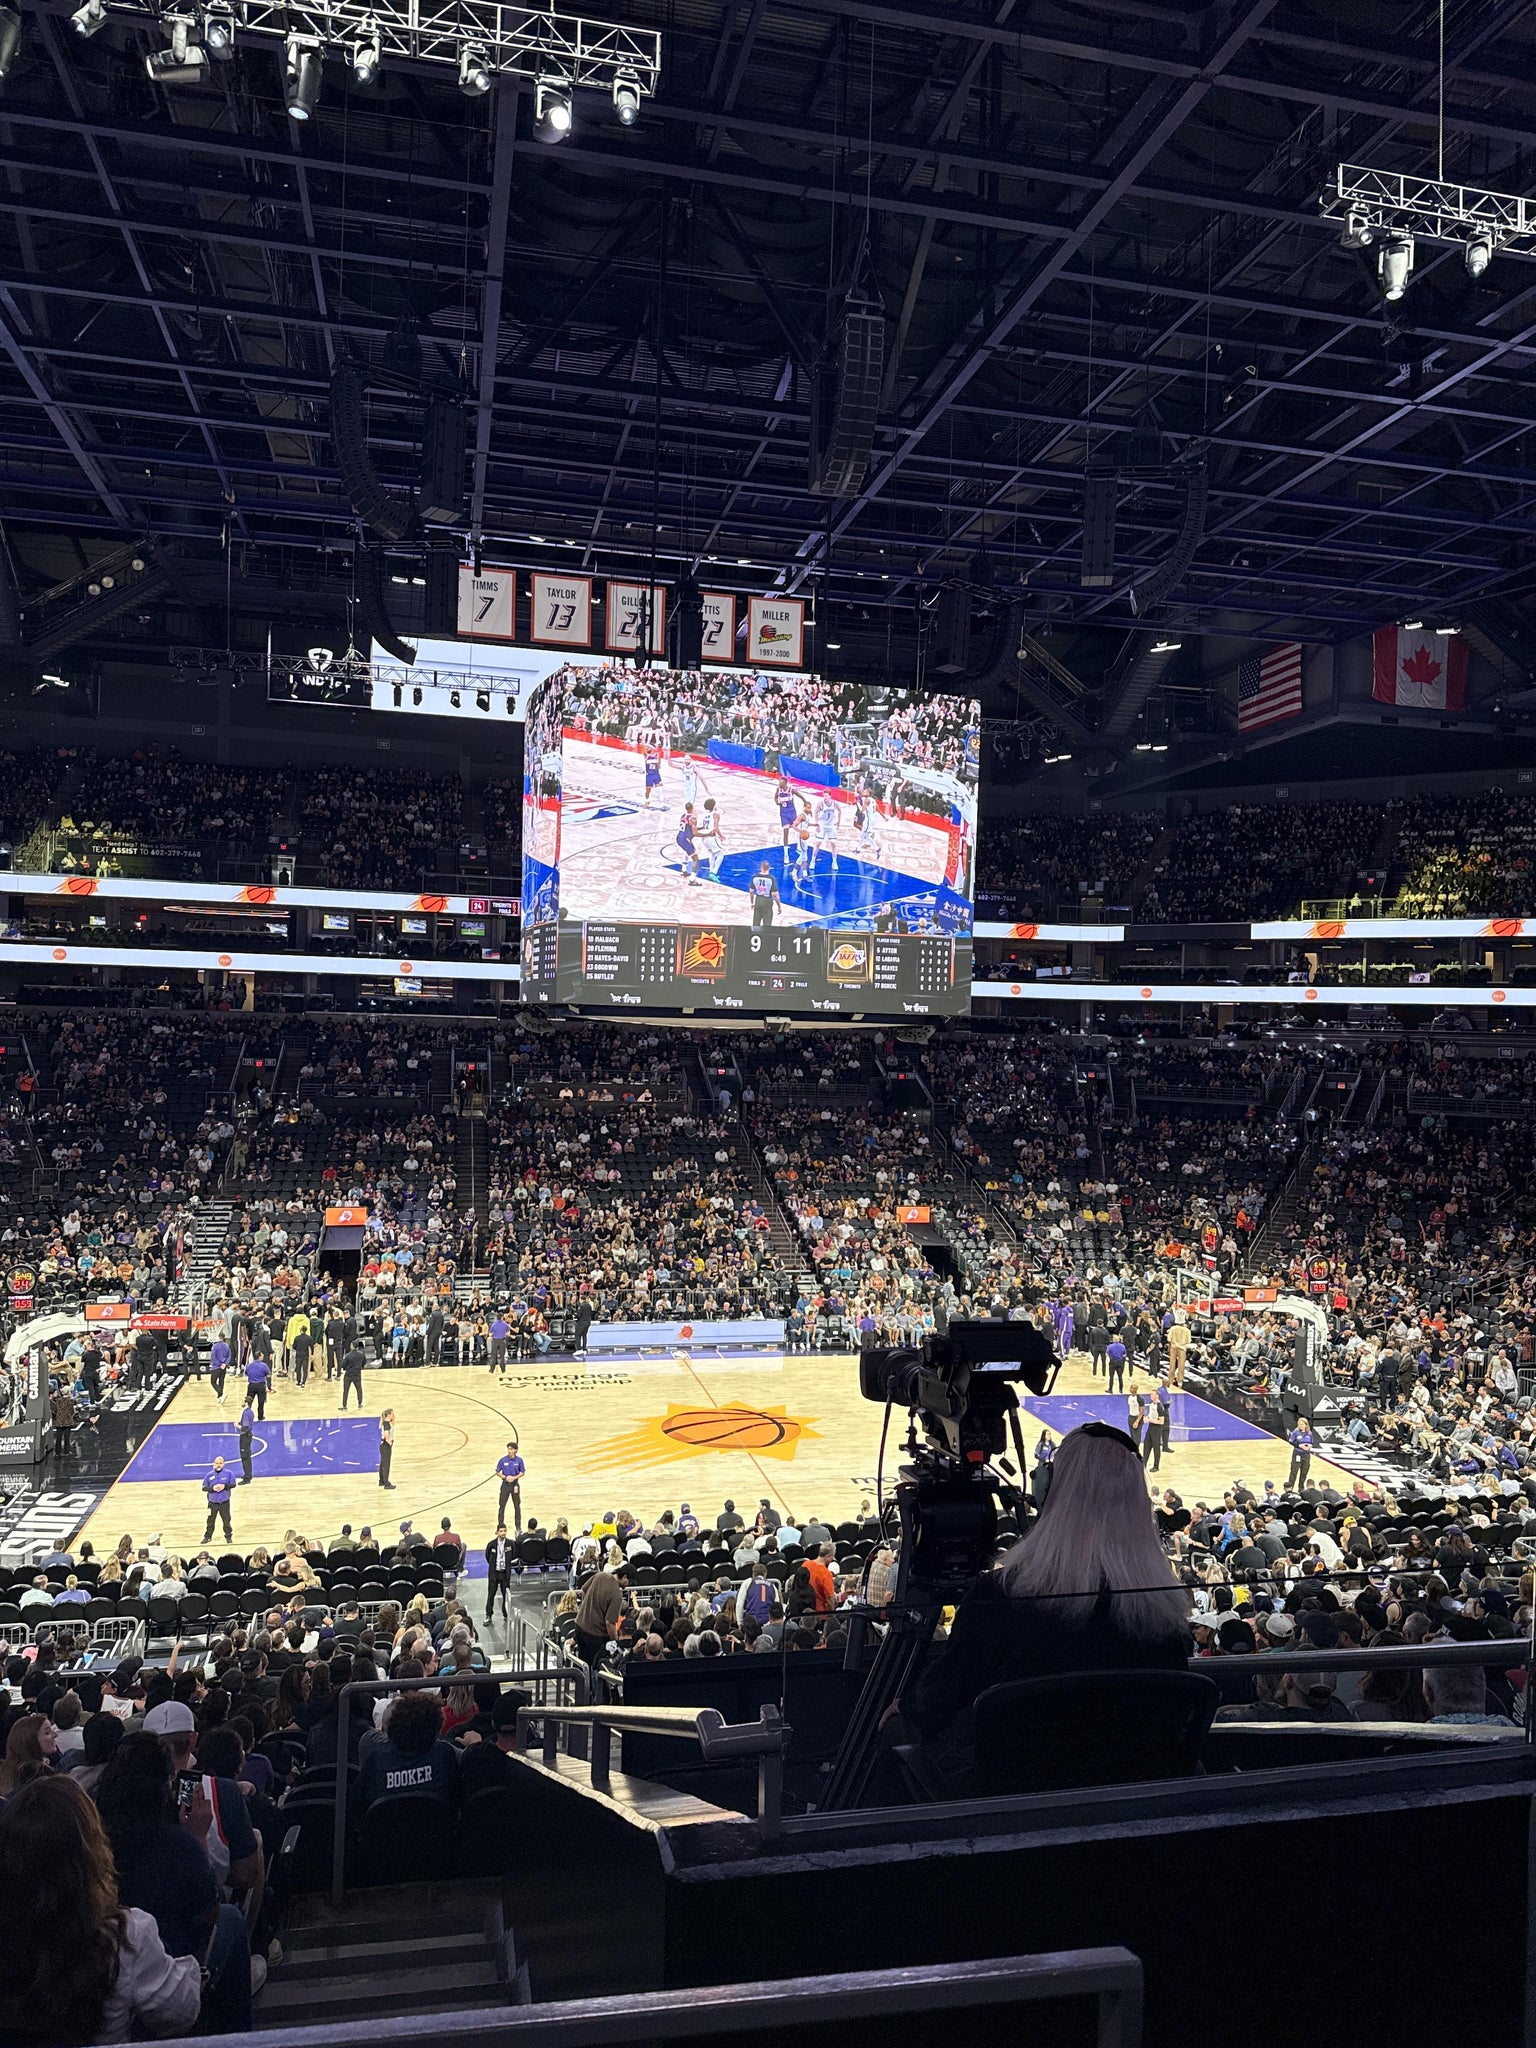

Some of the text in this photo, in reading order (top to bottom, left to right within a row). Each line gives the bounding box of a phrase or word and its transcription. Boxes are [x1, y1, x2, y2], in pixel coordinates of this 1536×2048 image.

[471, 579, 499, 592] TIMMS
[547, 587, 577, 600] TAYLOR
[621, 596, 651, 608] GILL
[474, 595, 495, 622] 7
[546, 603, 577, 631] 13
[762, 609, 790, 622] MILLER
[759, 648, 790, 658] 1997-2000
[92, 845, 109, 853] TEXT
[110, 846, 138, 855] ASSIST
[473, 902, 482, 910] 24
[750, 935, 762, 952] 9
[792, 937, 812, 954] 11
[770, 954, 787, 962] 6:49
[832, 952, 862, 962] LAKERS
[772, 979, 783, 988] 24
[1203, 1234, 1216, 1251] 24
[15, 1272, 32, 1281] 6:49
[1313, 1268, 1324, 1277] 24
[13, 1280, 29, 1291] 24
[143, 1319, 177, 1328] State Farm
[498, 1373, 629, 1382] mortgage
[0, 1491, 98, 1556] SUNS
[385, 1765, 433, 1789] BOOKER
